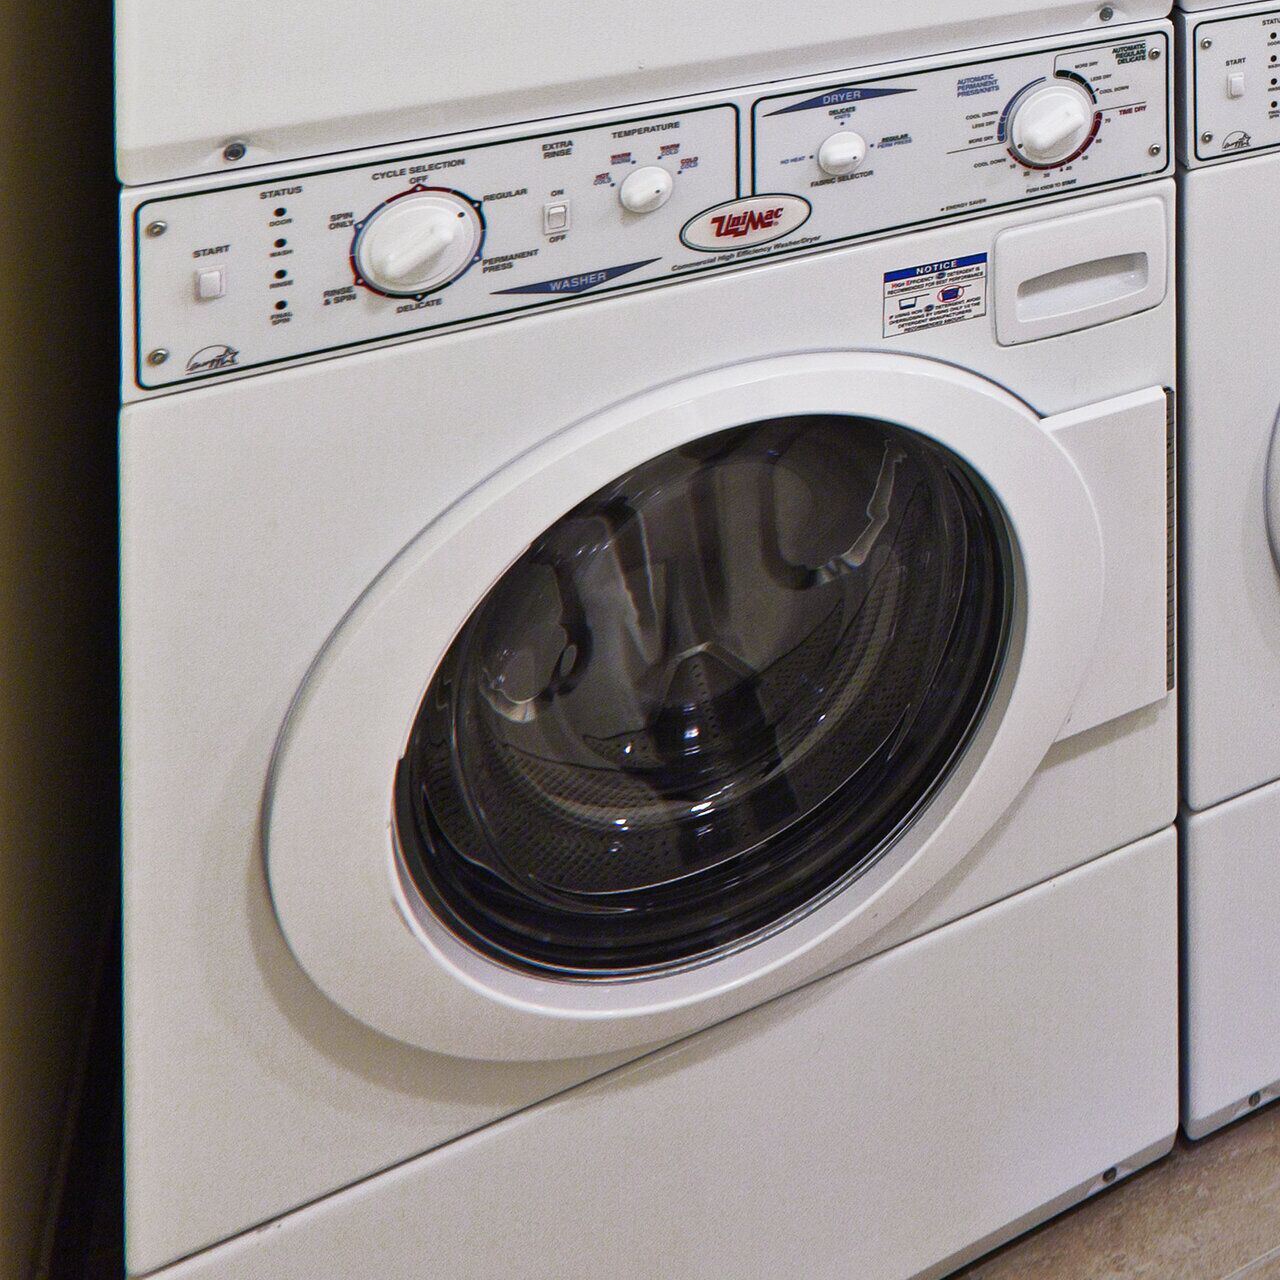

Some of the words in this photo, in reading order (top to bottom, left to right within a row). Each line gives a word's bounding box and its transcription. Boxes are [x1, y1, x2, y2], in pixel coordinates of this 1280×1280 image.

[1112, 42, 1146, 54] AUTOMATIC
[1117, 54, 1146, 65] DELICATE
[1226, 57, 1246, 66] START
[957, 74, 994, 85] AUTOMATIC
[957, 79, 998, 92] PERMANENT
[823, 90, 861, 104] DRYER
[982, 110, 998, 118] DOWN
[1119, 108, 1133, 116] TIME
[1134, 105, 1147, 113] DRY
[612, 121, 680, 139] TEMPERATURE
[542, 140, 573, 151] EXTRA
[543, 148, 572, 159] RINSE
[372, 169, 406, 181] CYCLE
[409, 159, 465, 174] SELECTION
[409, 175, 428, 184] OFF
[811, 178, 836, 187] FABRIC
[837, 170, 873, 182] SELECTOR
[260, 186, 302, 199] STATUS
[483, 188, 528, 202] REGULAR
[946, 203, 968, 212] ENERGY
[331, 212, 353, 221] SPIN
[710, 207, 784, 238] UniMac
[269, 219, 292, 227] DOOR
[329, 220, 354, 230] ONLY
[549, 234, 566, 243] OFF
[192, 245, 230, 258] START
[482, 249, 539, 266] PERMANENT
[672, 257, 716, 271] Commercial
[717, 253, 735, 263] High
[736, 245, 772, 258] Efficiency
[483, 262, 513, 273] PRESS
[916, 260, 957, 275] NOTICE
[550, 272, 607, 291] WASHER
[906, 276, 933, 286] EFFICIENCY
[324, 286, 353, 298] RINSE
[324, 297, 332, 305] &
[334, 293, 356, 304] SPIN
[396, 298, 442, 313] DELICATE
